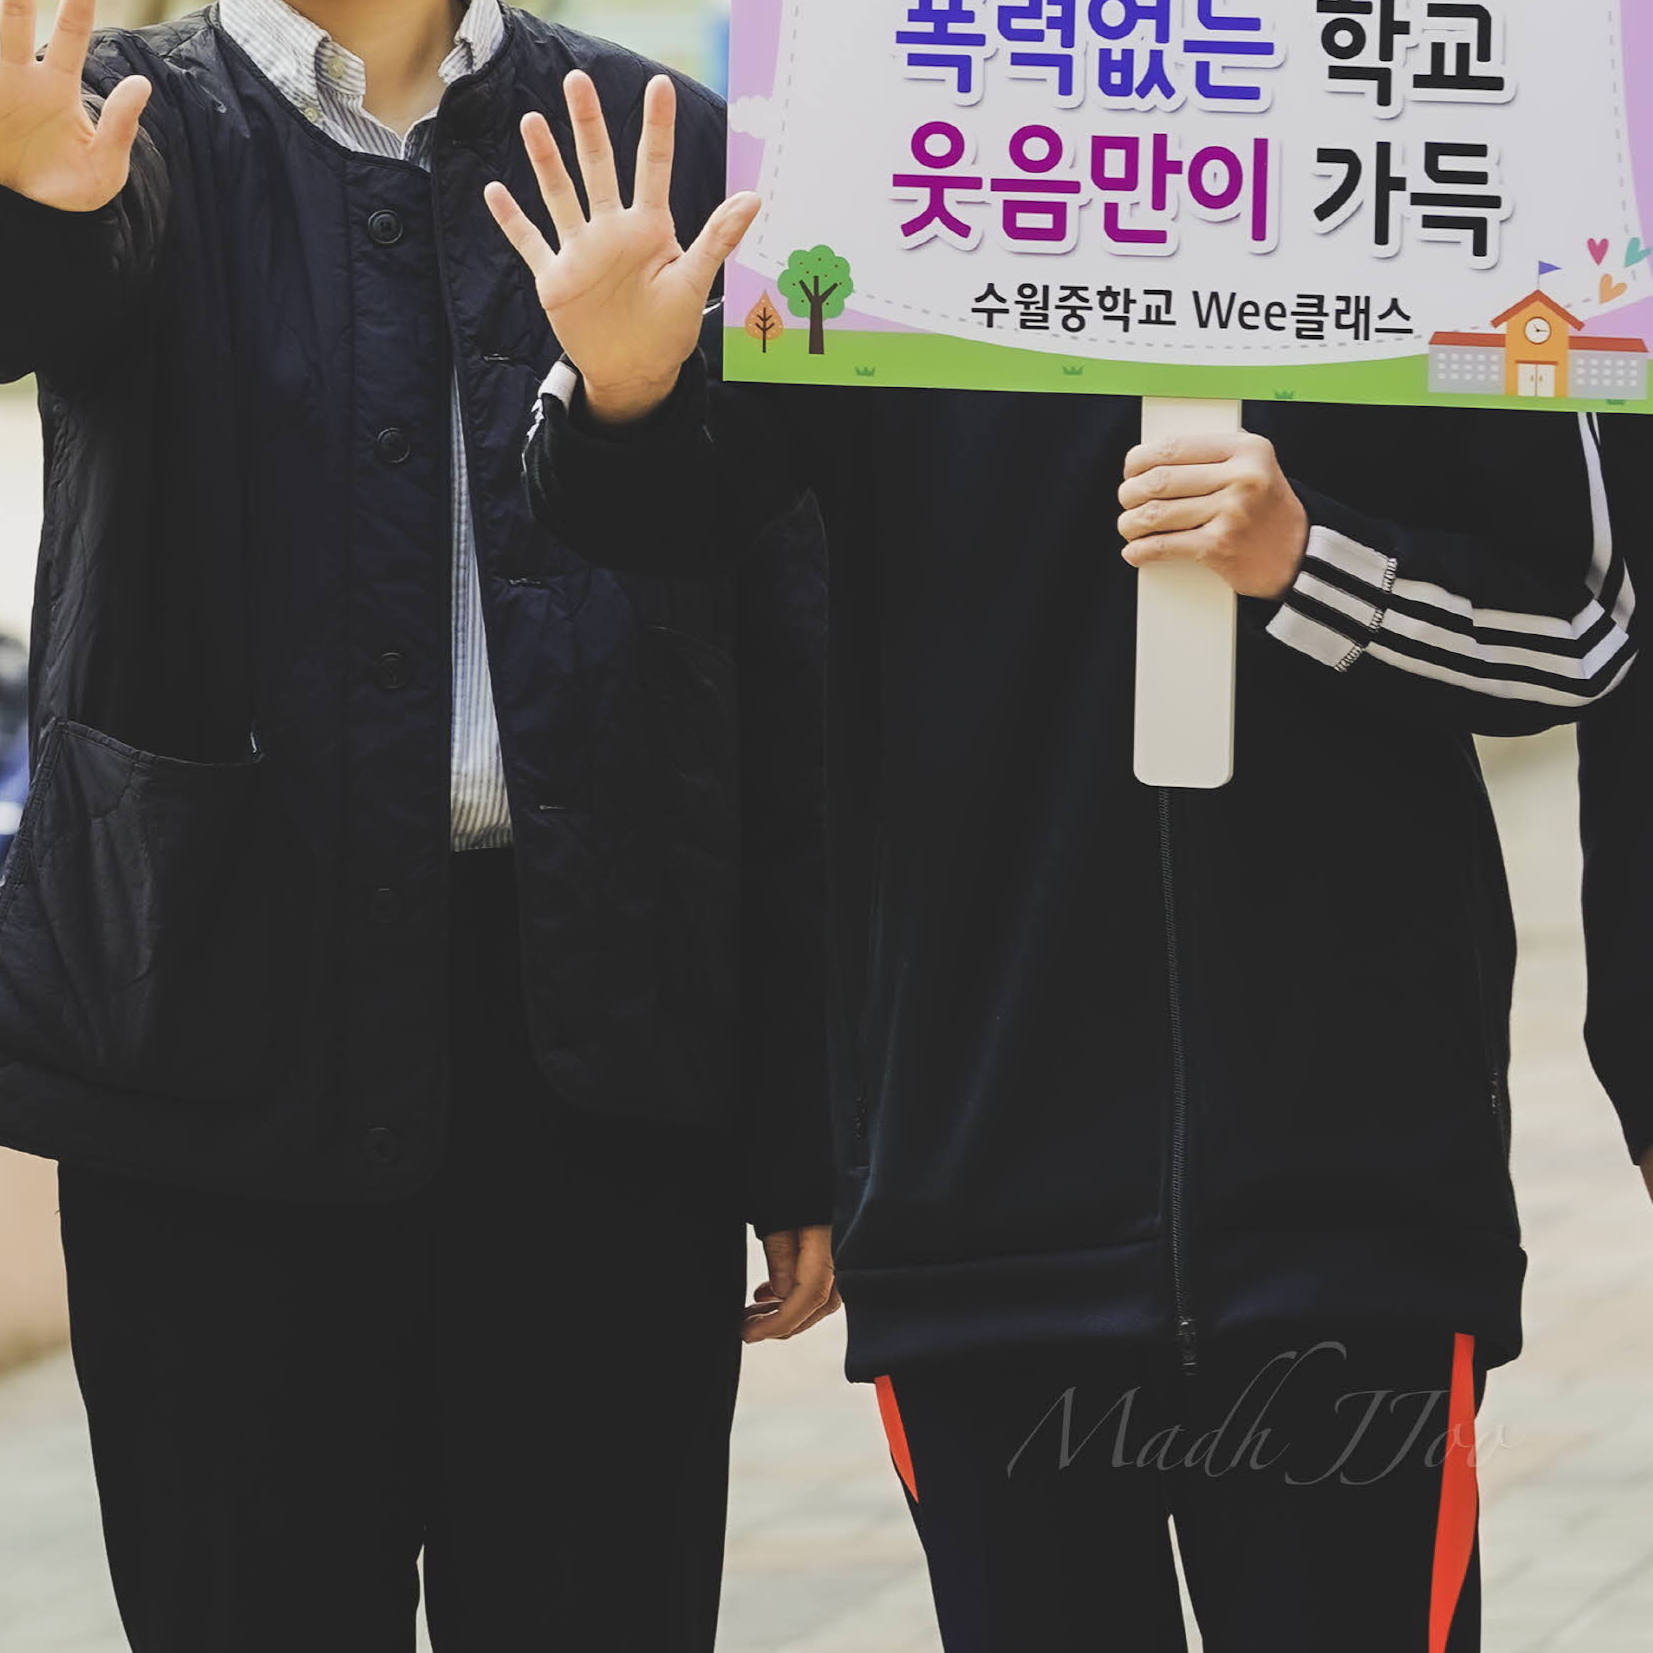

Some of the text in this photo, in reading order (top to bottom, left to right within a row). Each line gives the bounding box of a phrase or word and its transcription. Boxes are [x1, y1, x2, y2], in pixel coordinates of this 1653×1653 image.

[891, 119, 1506, 260] 웃음만이 가득
[970, 281, 1415, 342] 수월중학교 Wee클래스
